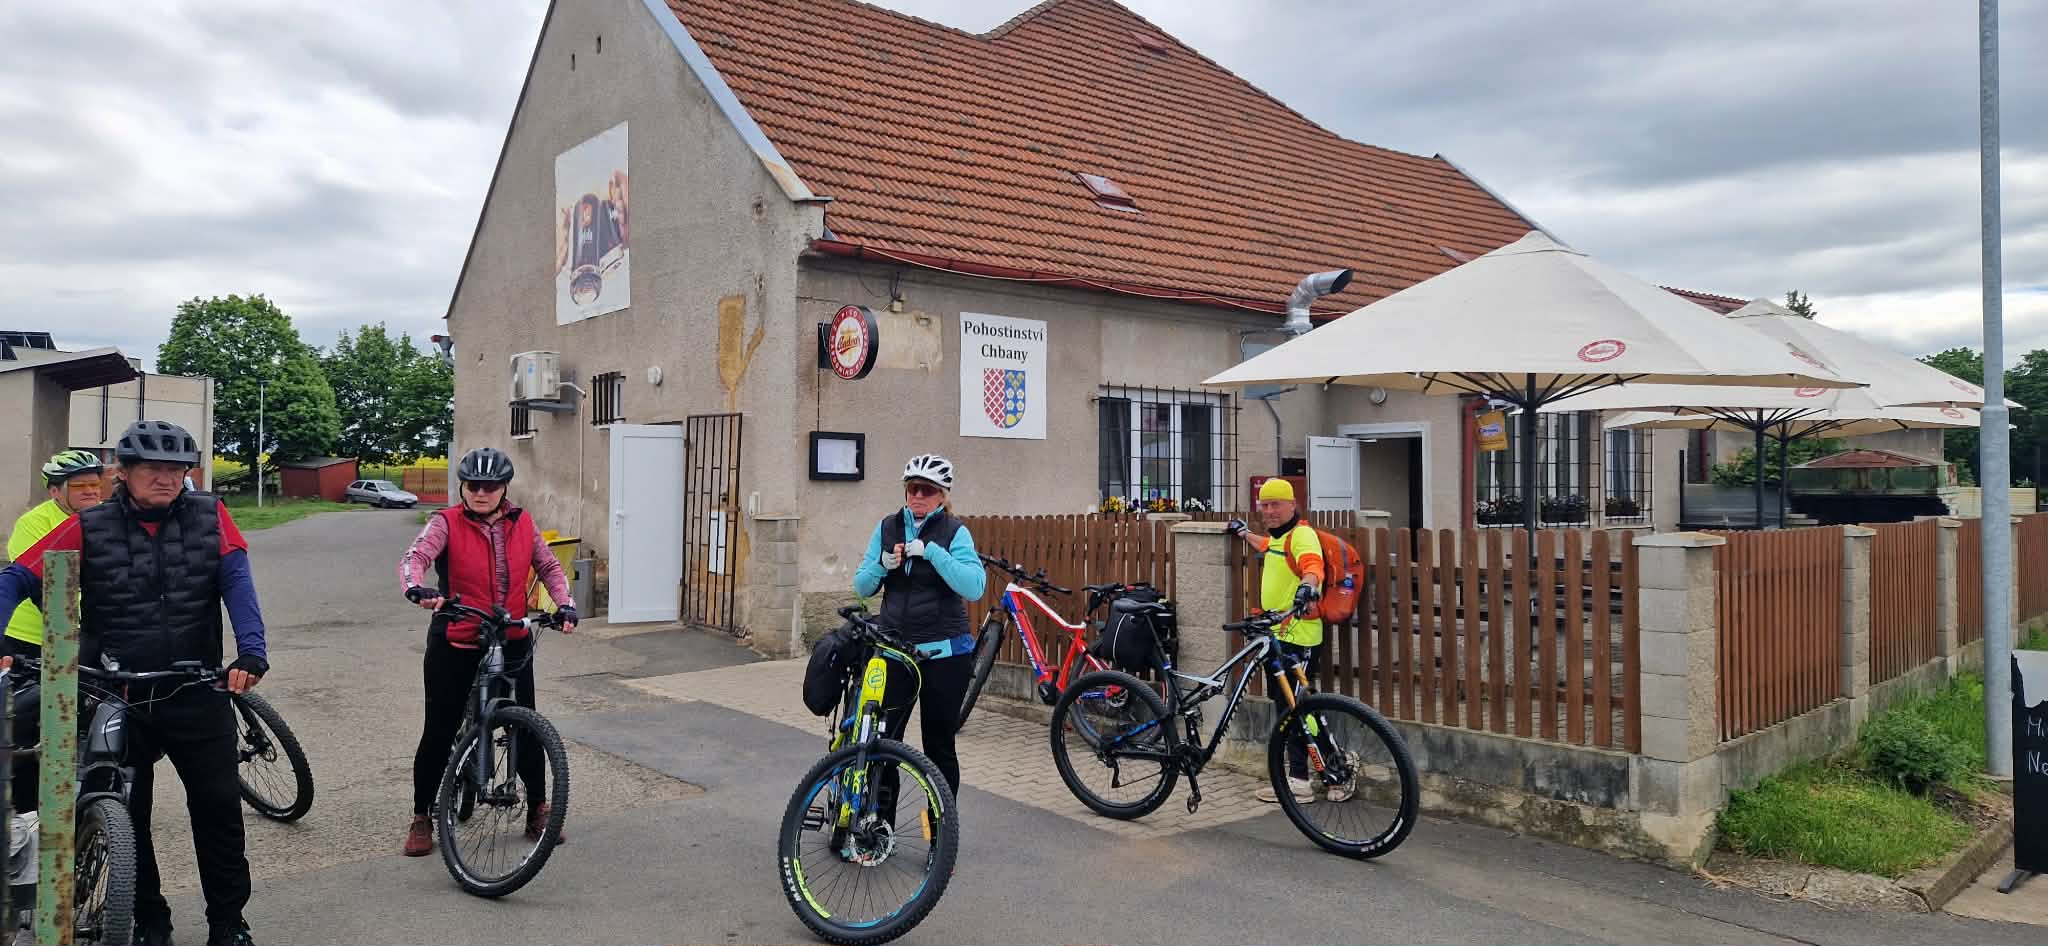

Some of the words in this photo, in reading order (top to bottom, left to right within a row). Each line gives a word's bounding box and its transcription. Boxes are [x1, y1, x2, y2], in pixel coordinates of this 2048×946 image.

[964, 320, 1044, 342] Pohostinství
[981, 344, 1029, 365] Chbany
[783, 857, 802, 902] MAXXIS
